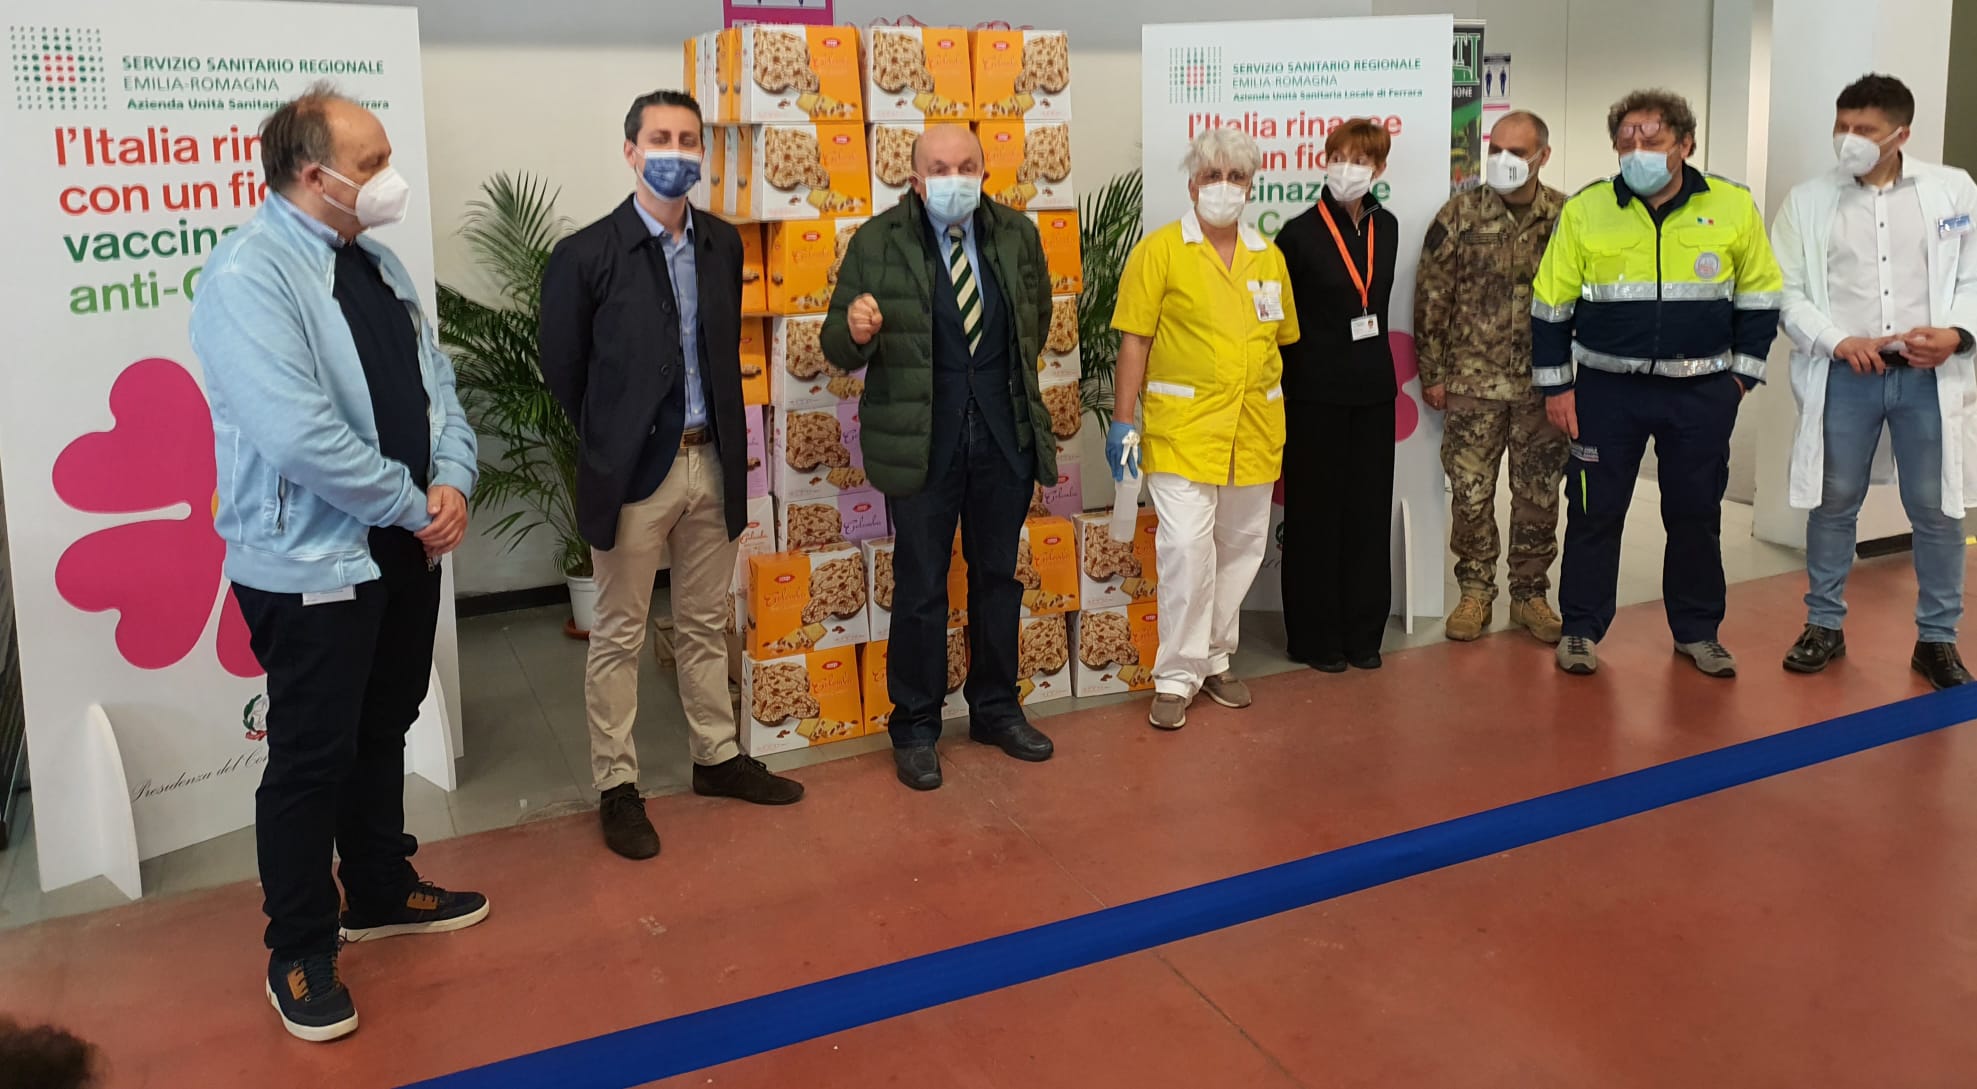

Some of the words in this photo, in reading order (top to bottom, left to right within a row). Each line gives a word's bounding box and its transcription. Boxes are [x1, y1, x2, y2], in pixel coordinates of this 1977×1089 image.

[122, 56, 200, 72] SERVIZIO
[206, 57, 294, 73] SANITARIO
[299, 60, 385, 76] REGIONALE
[1233, 62, 1284, 76] SERVIZIO
[1288, 60, 1349, 74] SANITARIO
[1354, 58, 1421, 72] REGIONALE
[1453, 33, 1480, 86] TI
[123, 76, 280, 92] EMILIA-ROMAGNA
[1453, 86, 1472, 98] IONE
[127, 98, 184, 111] Azienda
[188, 96, 225, 111] Unità
[1300, 90, 1342, 101] Sanitaria
[1286, 110, 1402, 139] rinae
[213, 125, 263, 163] rin
[59, 183, 151, 216] con
[162, 180, 219, 213] un
[215, 754, 245, 776] del
